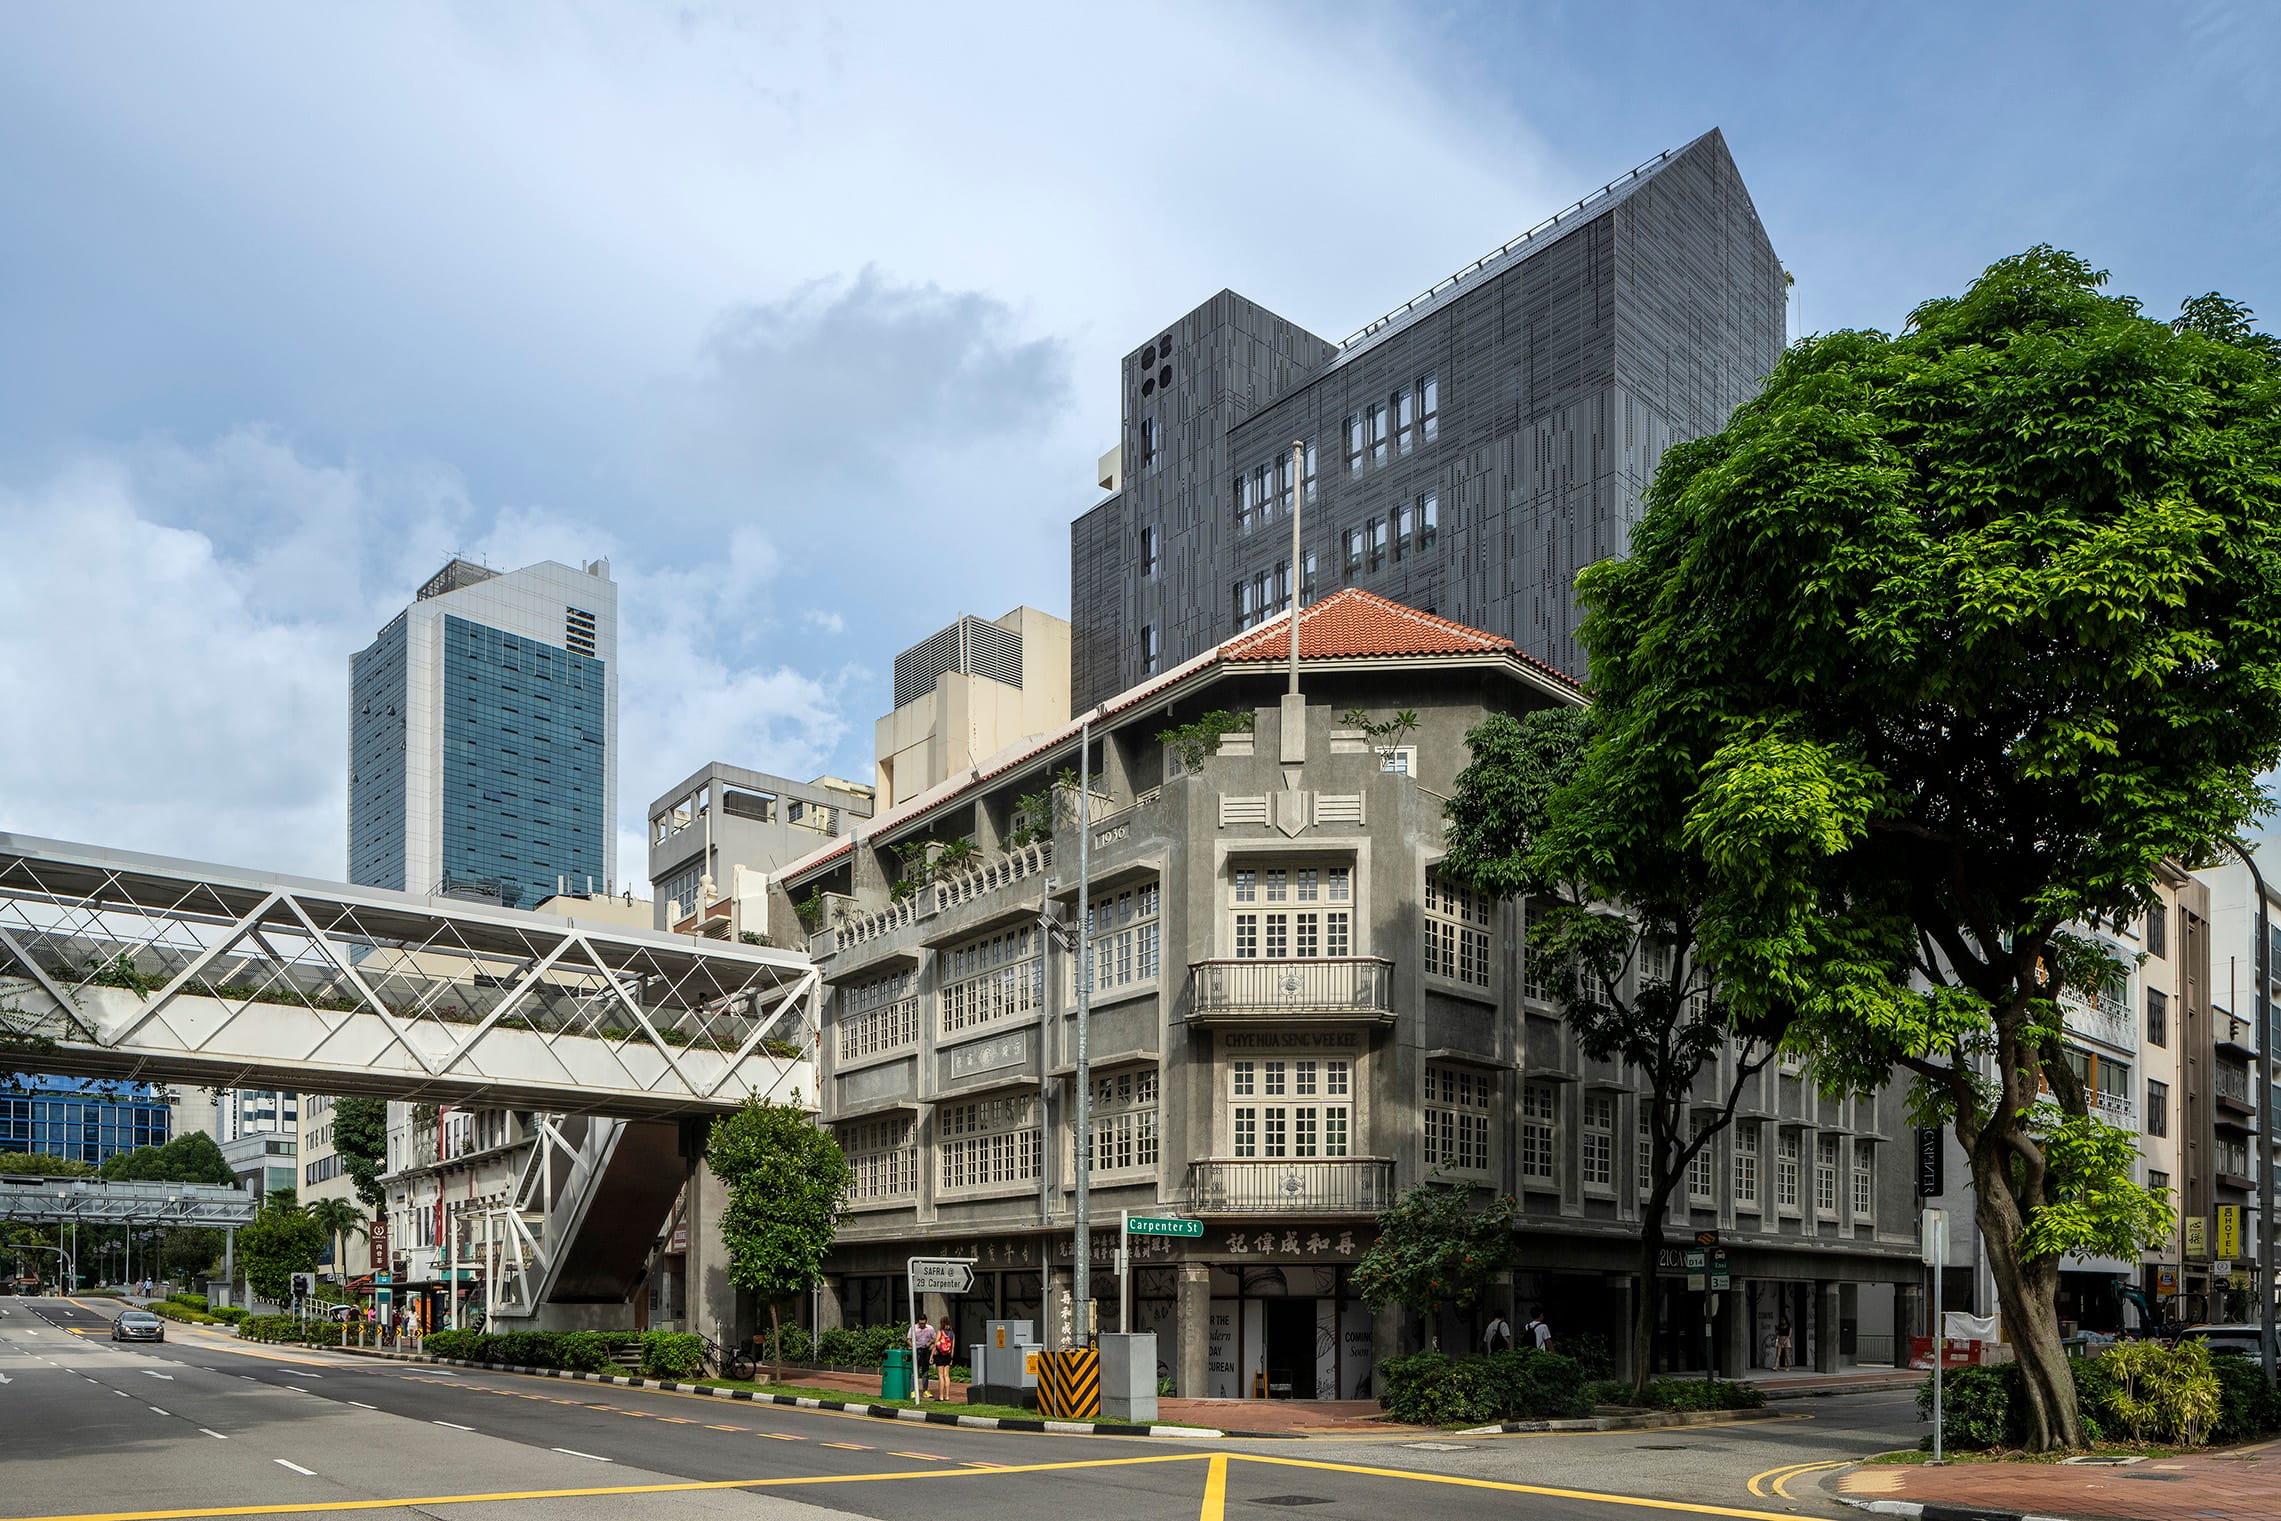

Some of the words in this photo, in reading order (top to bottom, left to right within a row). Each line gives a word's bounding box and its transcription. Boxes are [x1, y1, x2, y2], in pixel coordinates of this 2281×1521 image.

[1101, 825, 1126, 846] 1936
[1129, 1219, 1184, 1232] Carpenter
[1187, 1222, 1198, 1232] St
[2224, 1217, 2233, 1255] HOTEL
[923, 1266, 945, 1276] SAFRA
[947, 1267, 955, 1277] @
[928, 1278, 961, 1289] Carpenter
[1713, 1278, 1719, 1288] 3
[1216, 1315, 1230, 1326] THE
[1209, 1346, 1222, 1357] DAY
